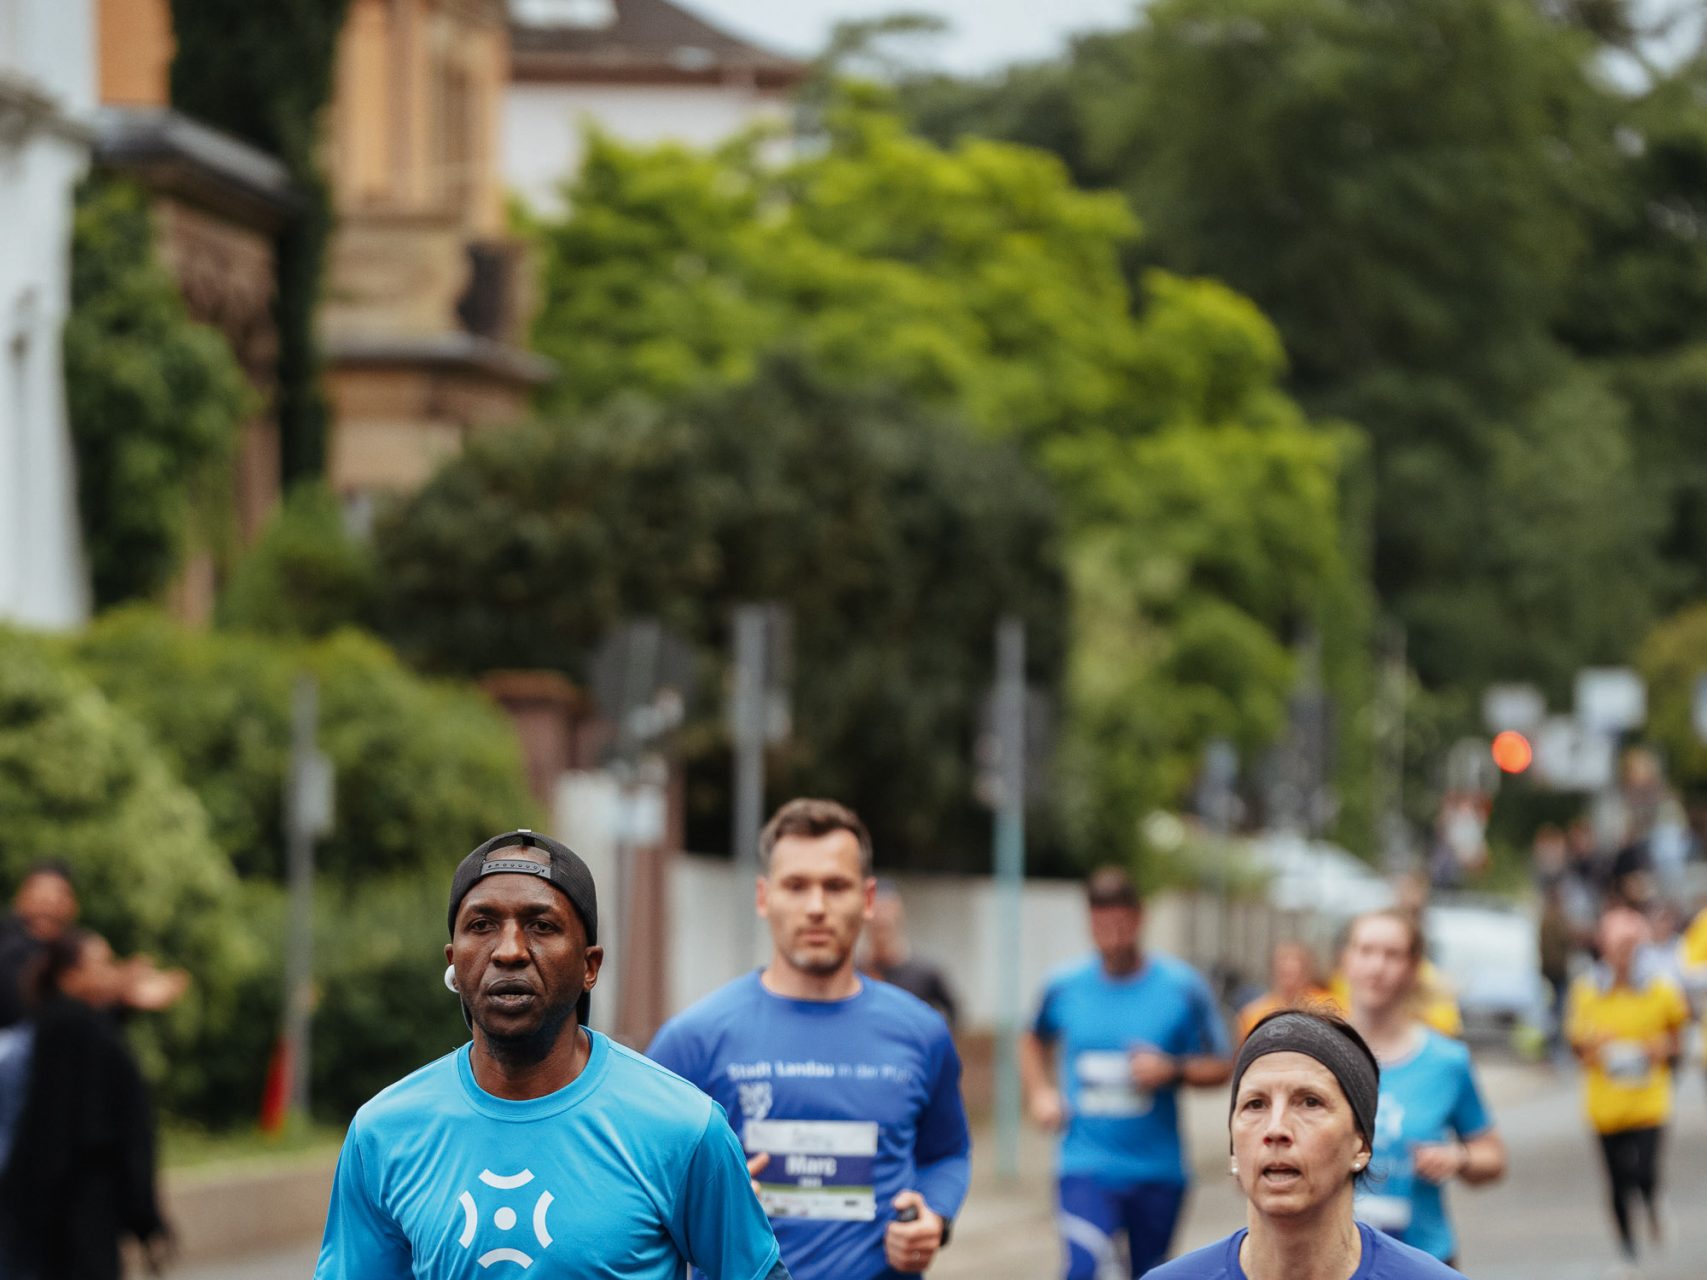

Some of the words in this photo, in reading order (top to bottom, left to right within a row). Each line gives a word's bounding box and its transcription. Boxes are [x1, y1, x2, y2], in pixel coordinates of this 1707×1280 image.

[727, 1062, 772, 1081] Stadt
[774, 1060, 835, 1078] Landau
[785, 1155, 837, 1177] Marc
